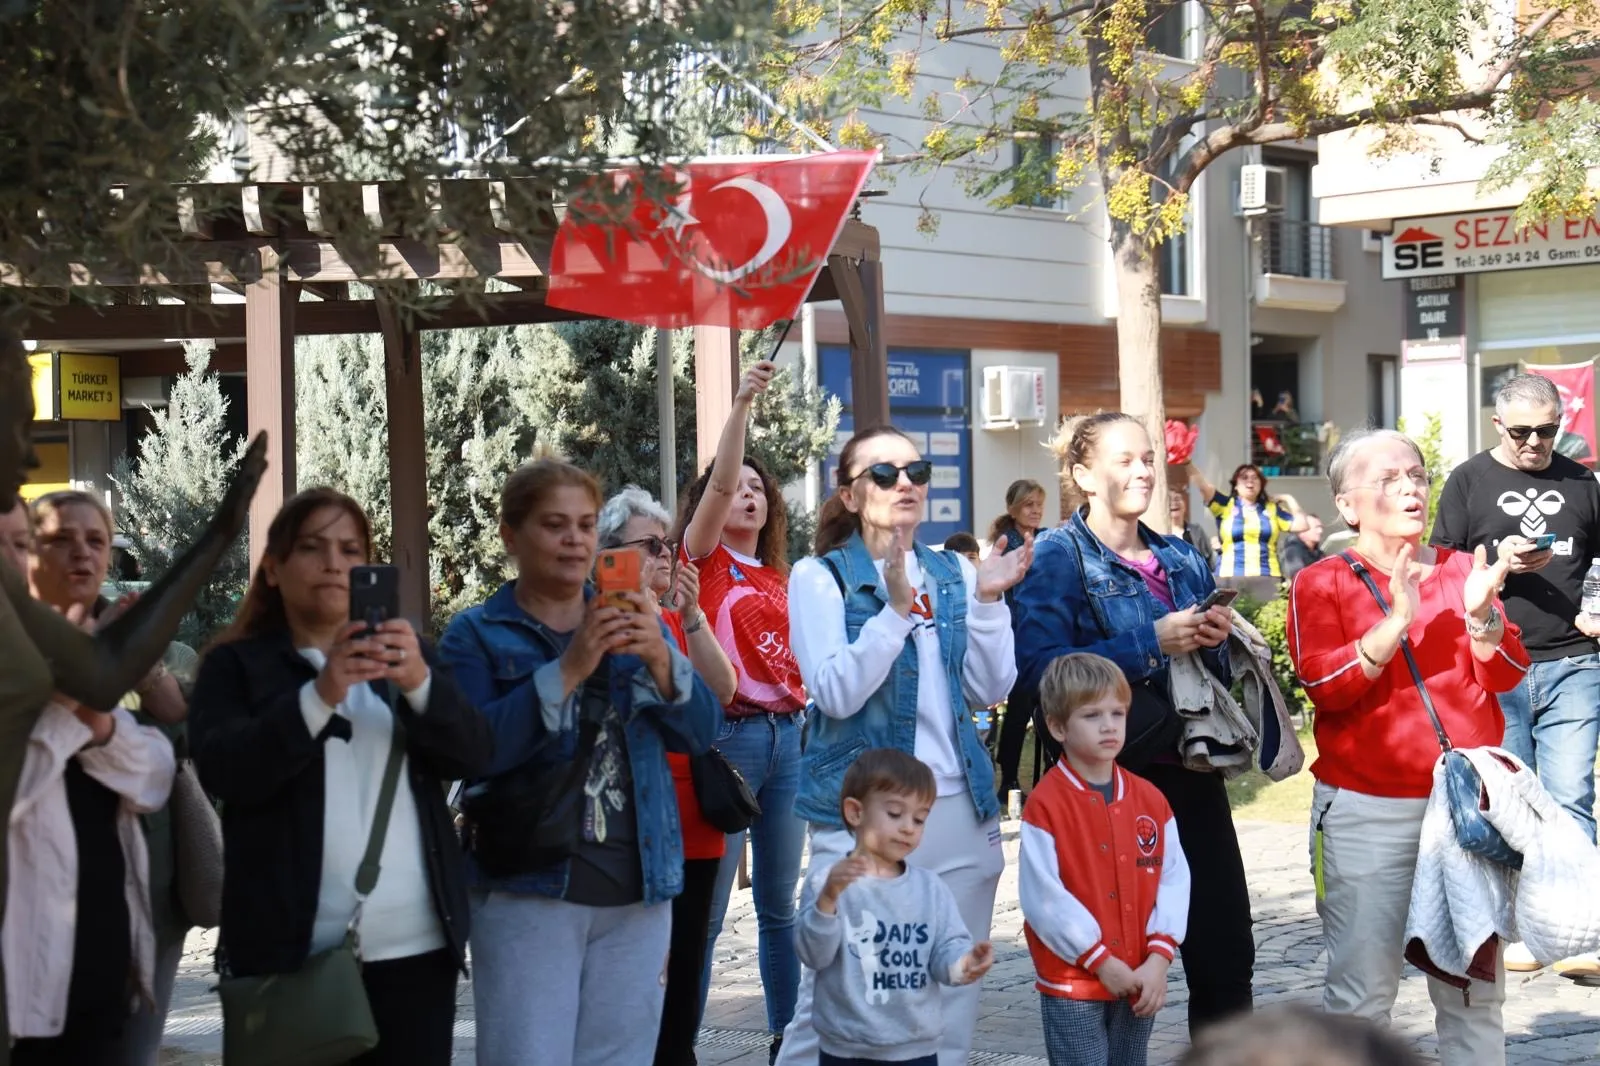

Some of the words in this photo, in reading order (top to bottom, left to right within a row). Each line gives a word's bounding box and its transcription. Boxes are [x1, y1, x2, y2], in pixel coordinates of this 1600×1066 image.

[1394, 241, 1443, 270] SE
[1455, 256, 1475, 268] Tel:
[1480, 254, 1501, 266] 369
[1506, 252, 1520, 264] 34
[1525, 250, 1540, 262] 24
[1548, 248, 1581, 260] Gsm:
[72, 371, 108, 385] TÜRKER
[888, 378, 920, 395] ORTA
[68, 389, 104, 402] MARKET
[106, 391, 113, 402] 3
[756, 631, 784, 657] 29
[880, 948, 923, 968] COOL
[873, 971, 927, 990] HELPER
